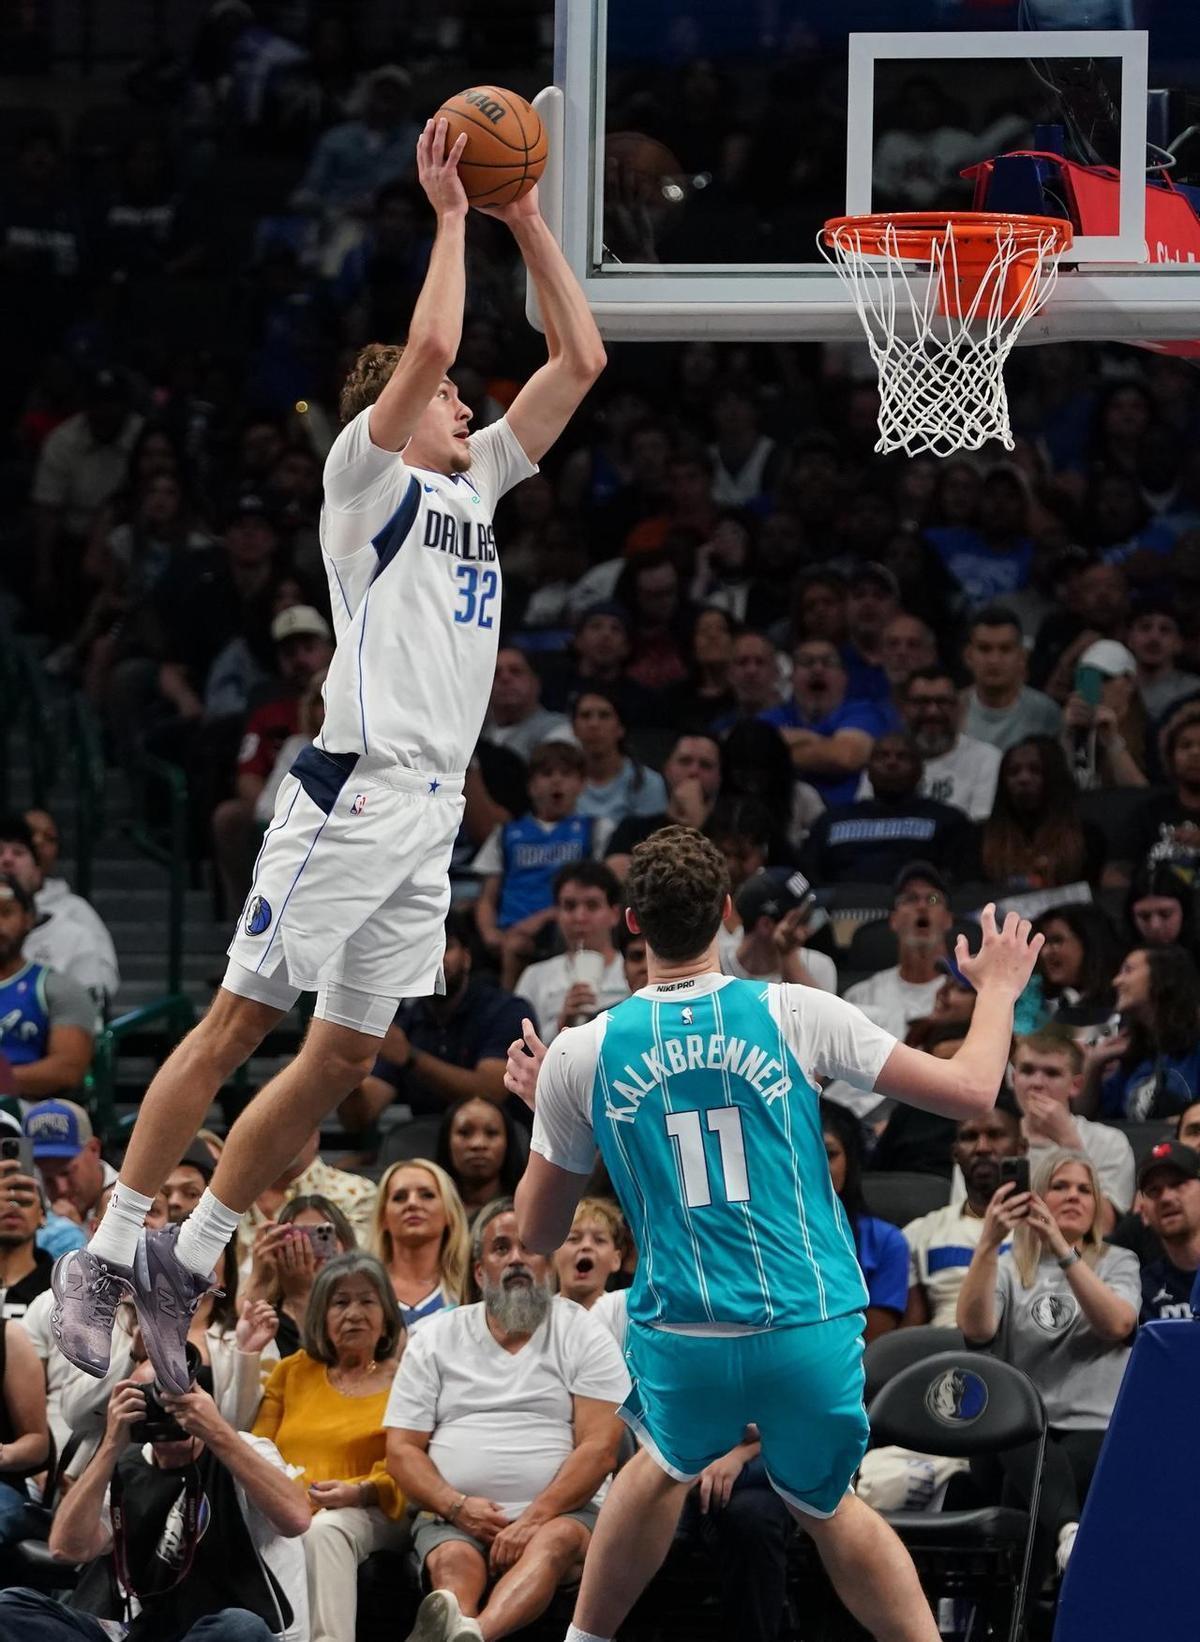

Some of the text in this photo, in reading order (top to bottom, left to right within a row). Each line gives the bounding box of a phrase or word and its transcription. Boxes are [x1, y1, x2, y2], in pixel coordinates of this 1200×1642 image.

[423, 509, 496, 562] DALLAS
[454, 564, 498, 628] 32
[656, 979, 695, 993] NIKE PRO
[605, 1034, 793, 1125] KALKBRENNER
[664, 1105, 751, 1208] 11
